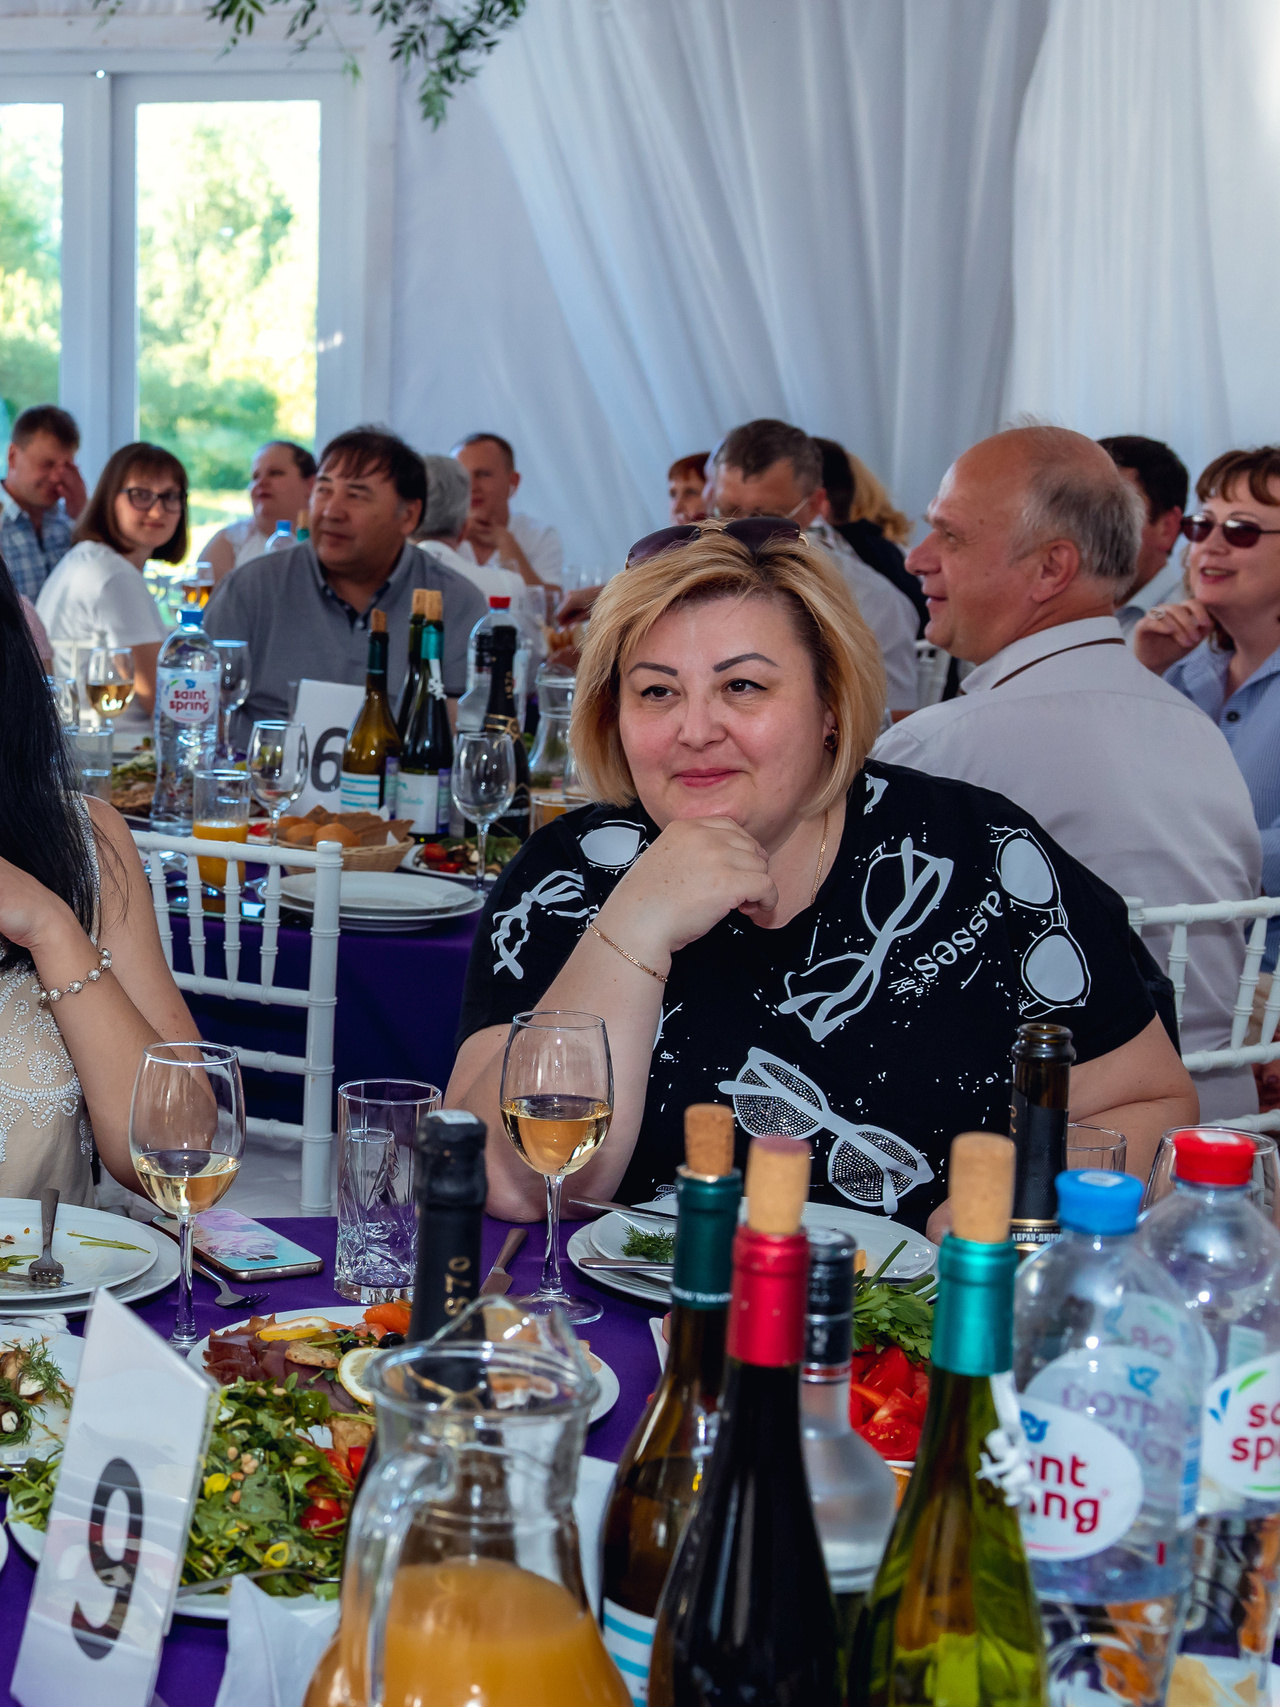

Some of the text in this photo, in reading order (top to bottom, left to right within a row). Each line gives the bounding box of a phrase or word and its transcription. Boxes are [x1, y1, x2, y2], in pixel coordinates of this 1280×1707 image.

[169, 701, 210, 714] spring
[173, 690, 207, 700] saint
[310, 726, 348, 792] 6
[70, 1457, 144, 1661] 9
